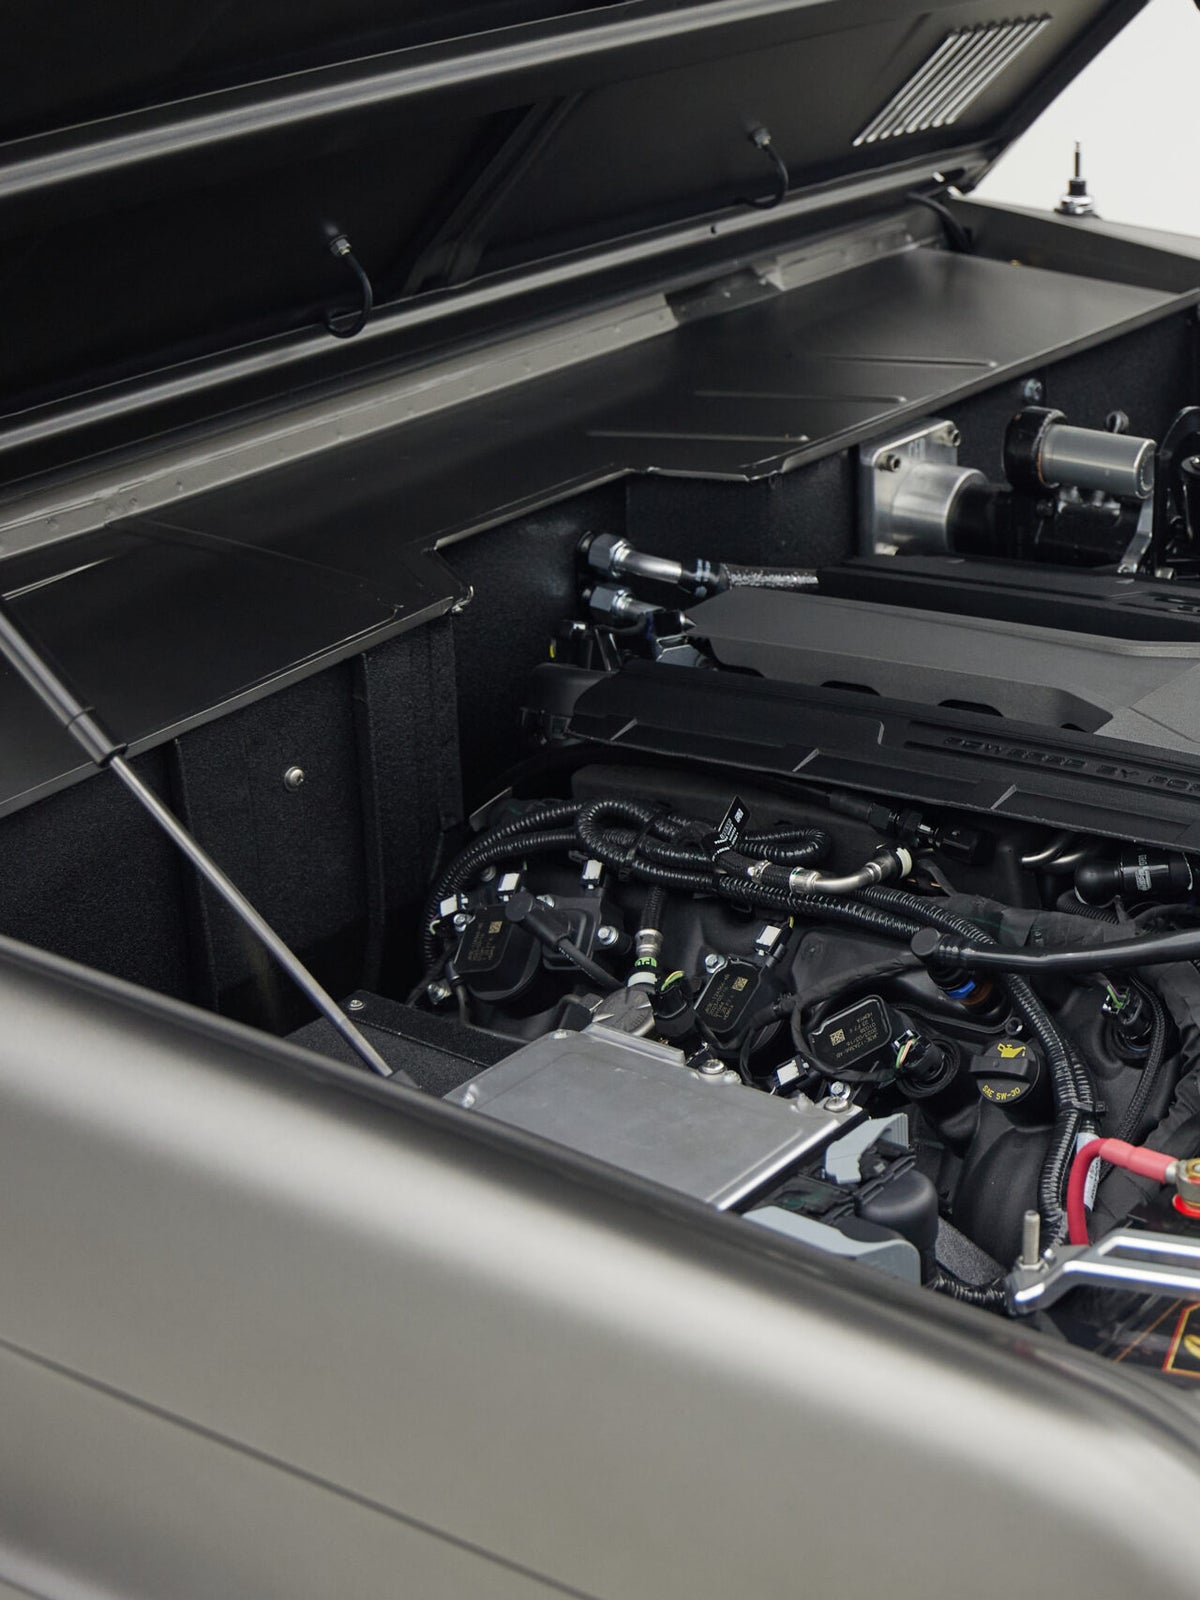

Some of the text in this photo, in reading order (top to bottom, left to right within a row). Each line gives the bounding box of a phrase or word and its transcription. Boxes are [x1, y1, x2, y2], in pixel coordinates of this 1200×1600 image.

[943, 736, 1087, 769] POWERED
[1096, 764, 1140, 779] BY
[982, 1084, 994, 1098] SAE
